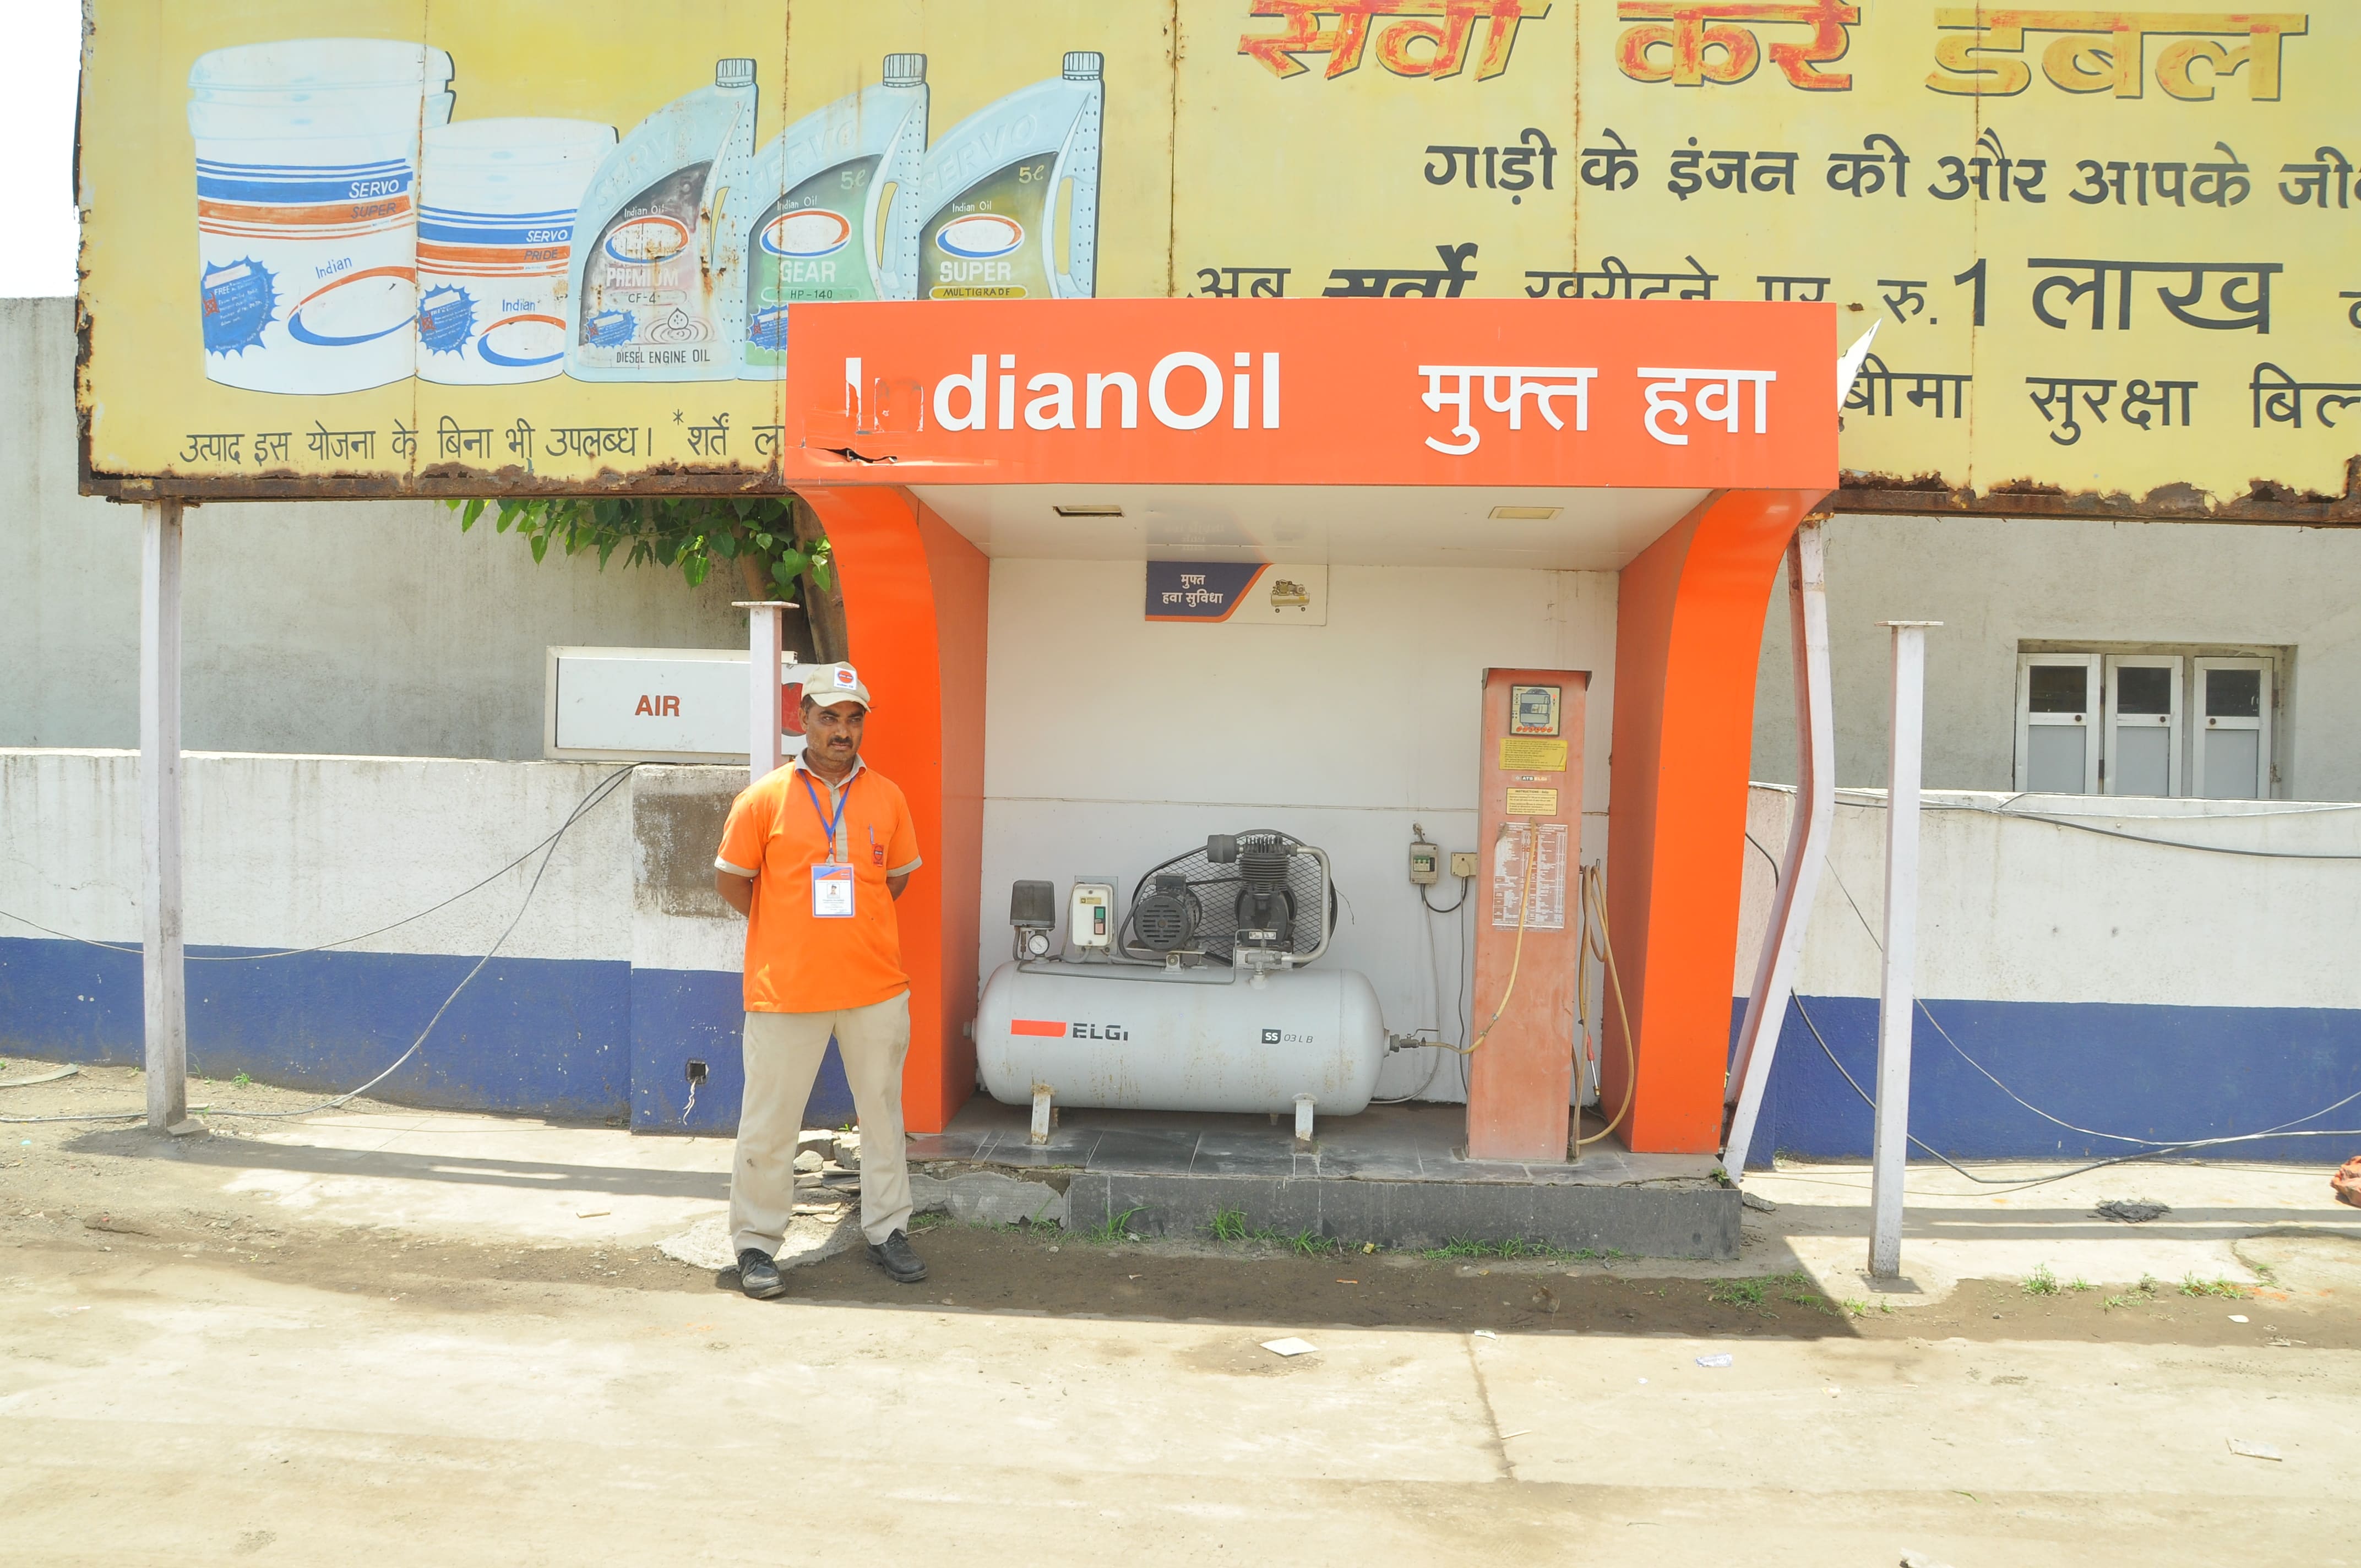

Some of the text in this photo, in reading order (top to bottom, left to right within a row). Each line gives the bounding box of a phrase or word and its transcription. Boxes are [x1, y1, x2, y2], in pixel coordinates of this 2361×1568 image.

[1925, 7, 2309, 101] डबल
[1424, 127, 2361, 208] गाड़ी के इंजन की और आपके जी
[349, 179, 399, 199] SERVO
[351, 202, 397, 219] SUPER
[624, 204, 665, 218] Indian Oil
[777, 195, 818, 211] Indian Oil
[952, 200, 992, 213] Indian Oil
[526, 230, 568, 242] SERVO
[524, 249, 558, 260] PRIDE
[315, 257, 352, 279] Indian
[780, 260, 836, 283] GEAR
[939, 261, 1011, 282] SUPER
[214, 285, 230, 296] FREE
[628, 292, 656, 304] CF-4
[943, 288, 1010, 297] MULTIGRADE
[1954, 258, 1987, 326] 1
[2028, 257, 2283, 335] लाख
[502, 299, 535, 312] Indian
[616, 349, 710, 364] DIESEL ENGINE OIL
[846, 351, 1280, 432] IdianOil
[1418, 365, 1776, 456] मुफ्त हवा
[2026, 376, 2198, 446] सुरक्षा
[179, 432, 244, 464] उत्पाद
[253, 432, 292, 464] इस
[307, 420, 376, 460] योजना
[392, 418, 419, 461] के
[437, 416, 493, 459] बिना
[505, 417, 535, 459] भी
[1180, 574, 1206, 589] मुफ्त
[1162, 589, 1223, 607] हवा सुविधा
[635, 695, 680, 717] AIR
[1265, 1032, 1279, 1041] SS
